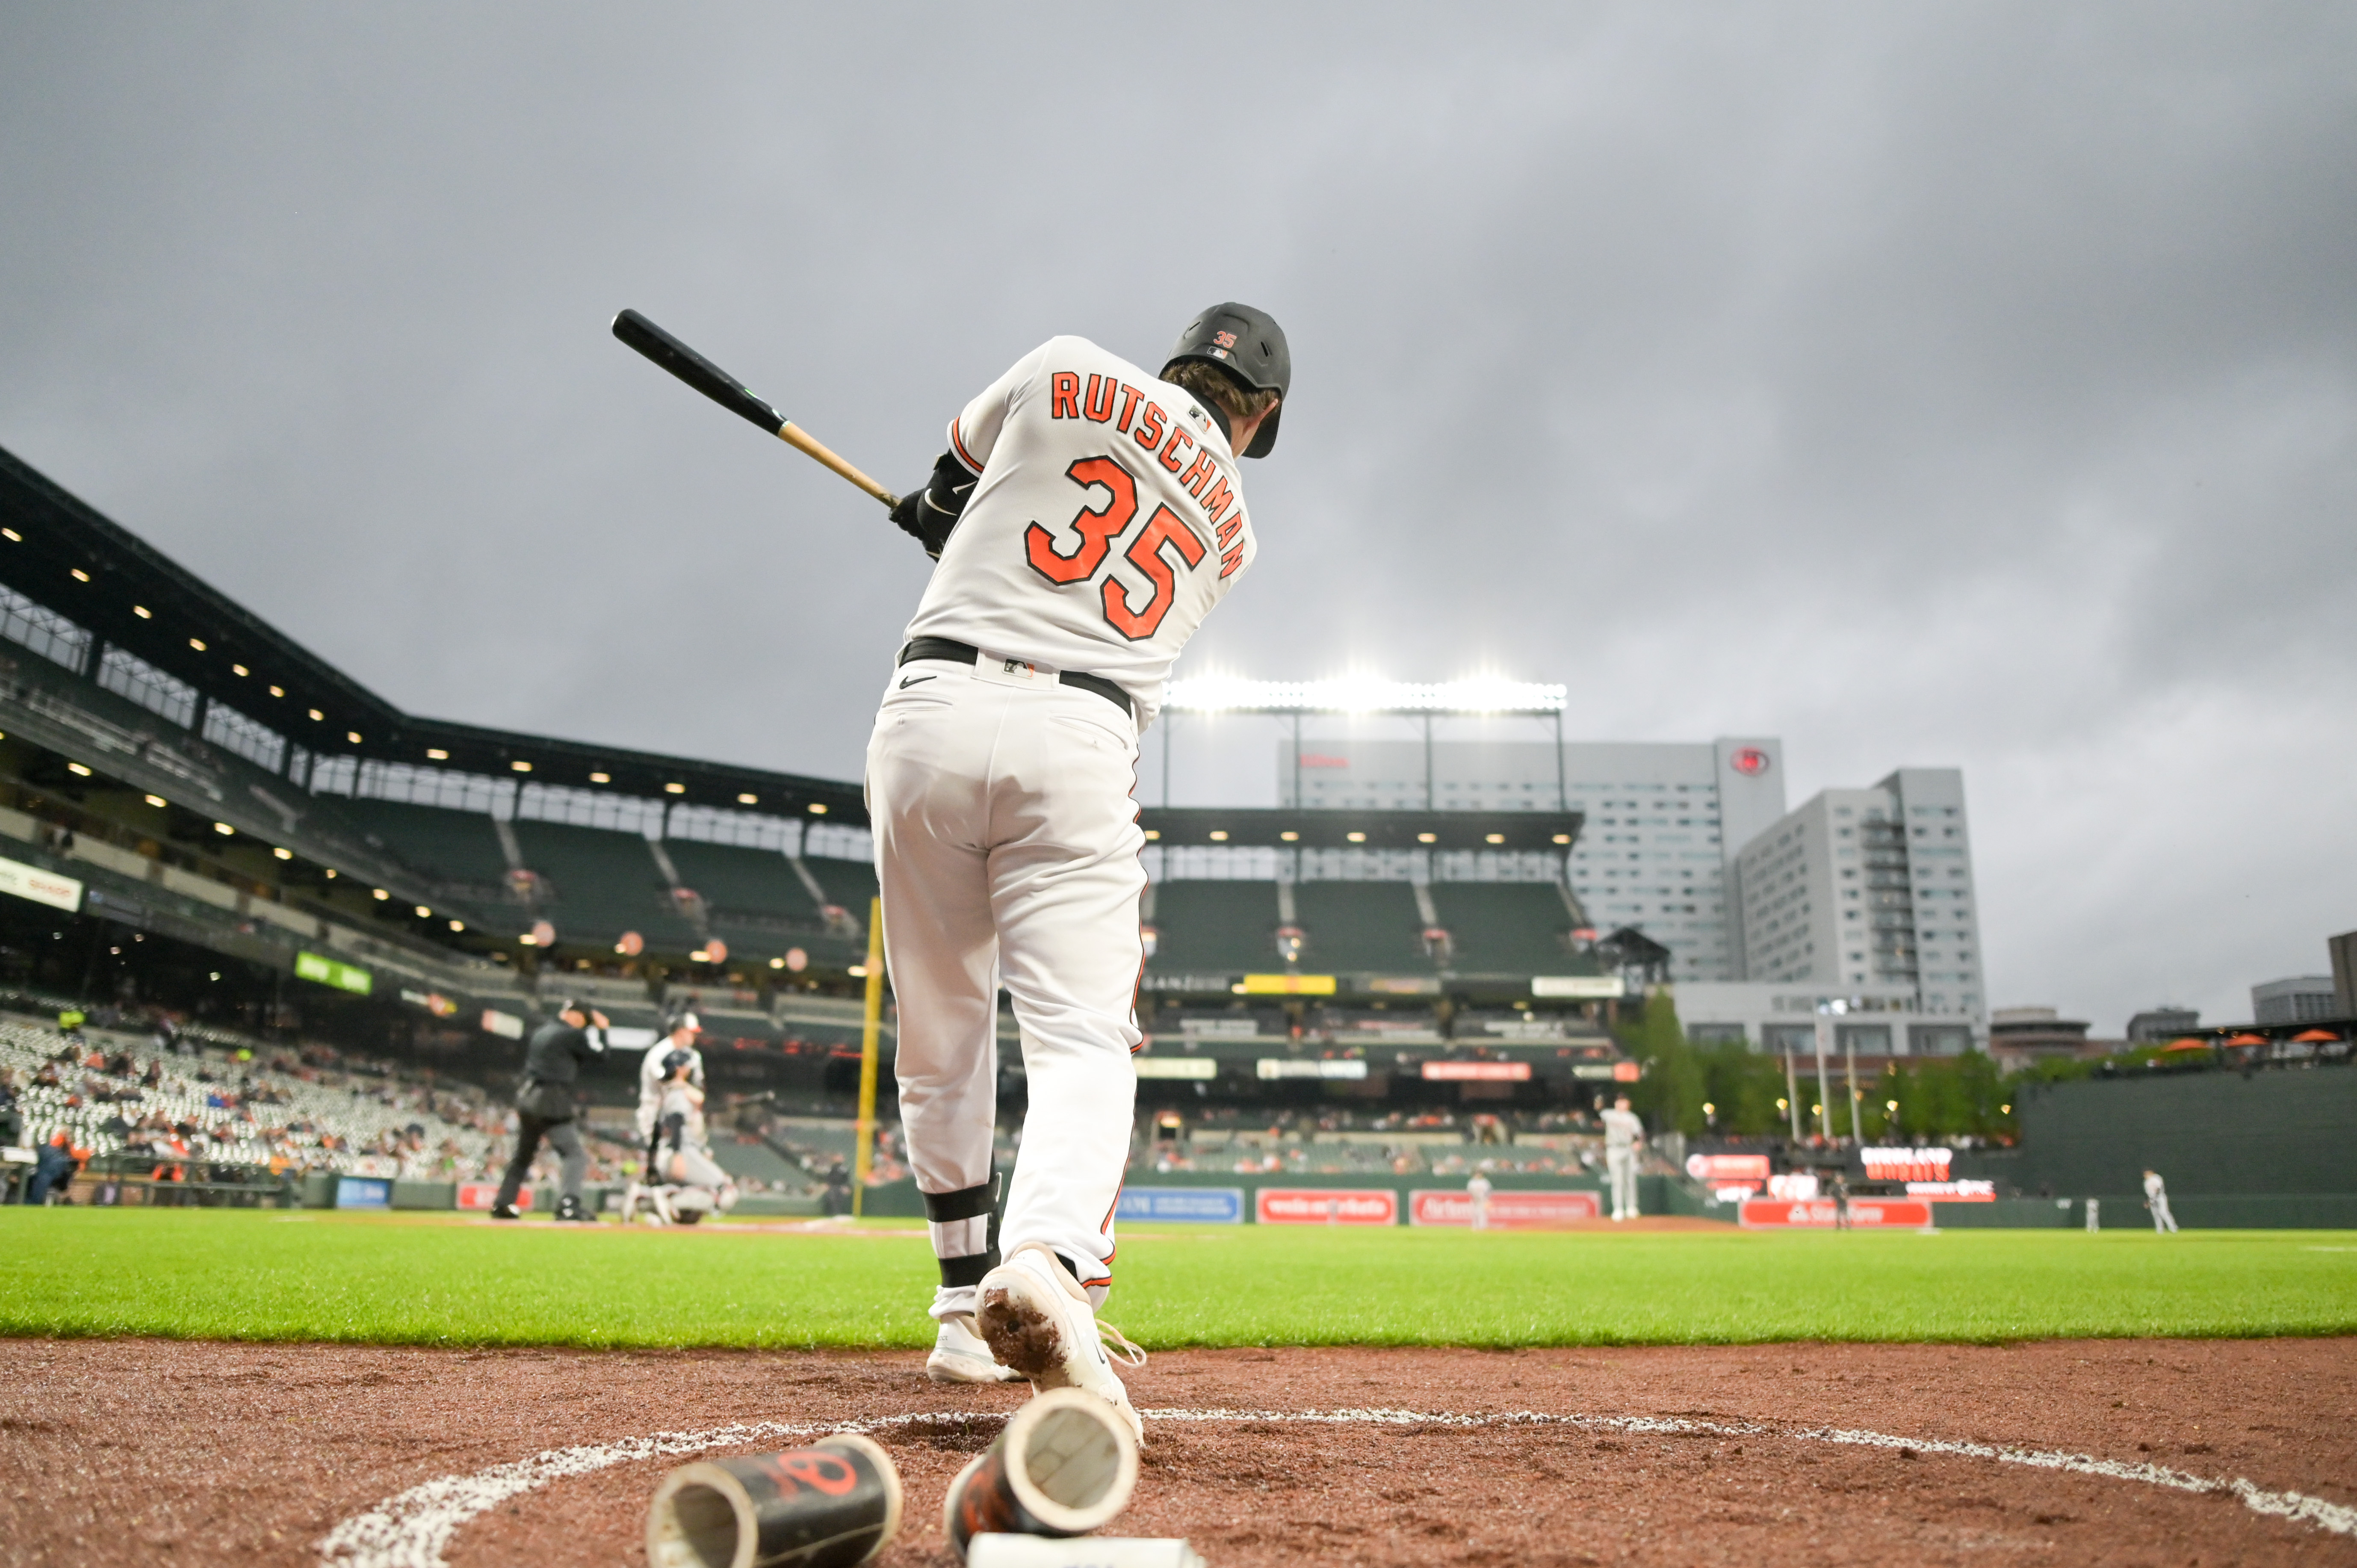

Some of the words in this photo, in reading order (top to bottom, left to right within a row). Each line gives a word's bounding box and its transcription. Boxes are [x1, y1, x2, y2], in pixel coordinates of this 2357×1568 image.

[1213, 331, 1237, 348] 35
[1024, 455, 1206, 641] 35
[1052, 371, 1243, 580] RUTSCHMAN
